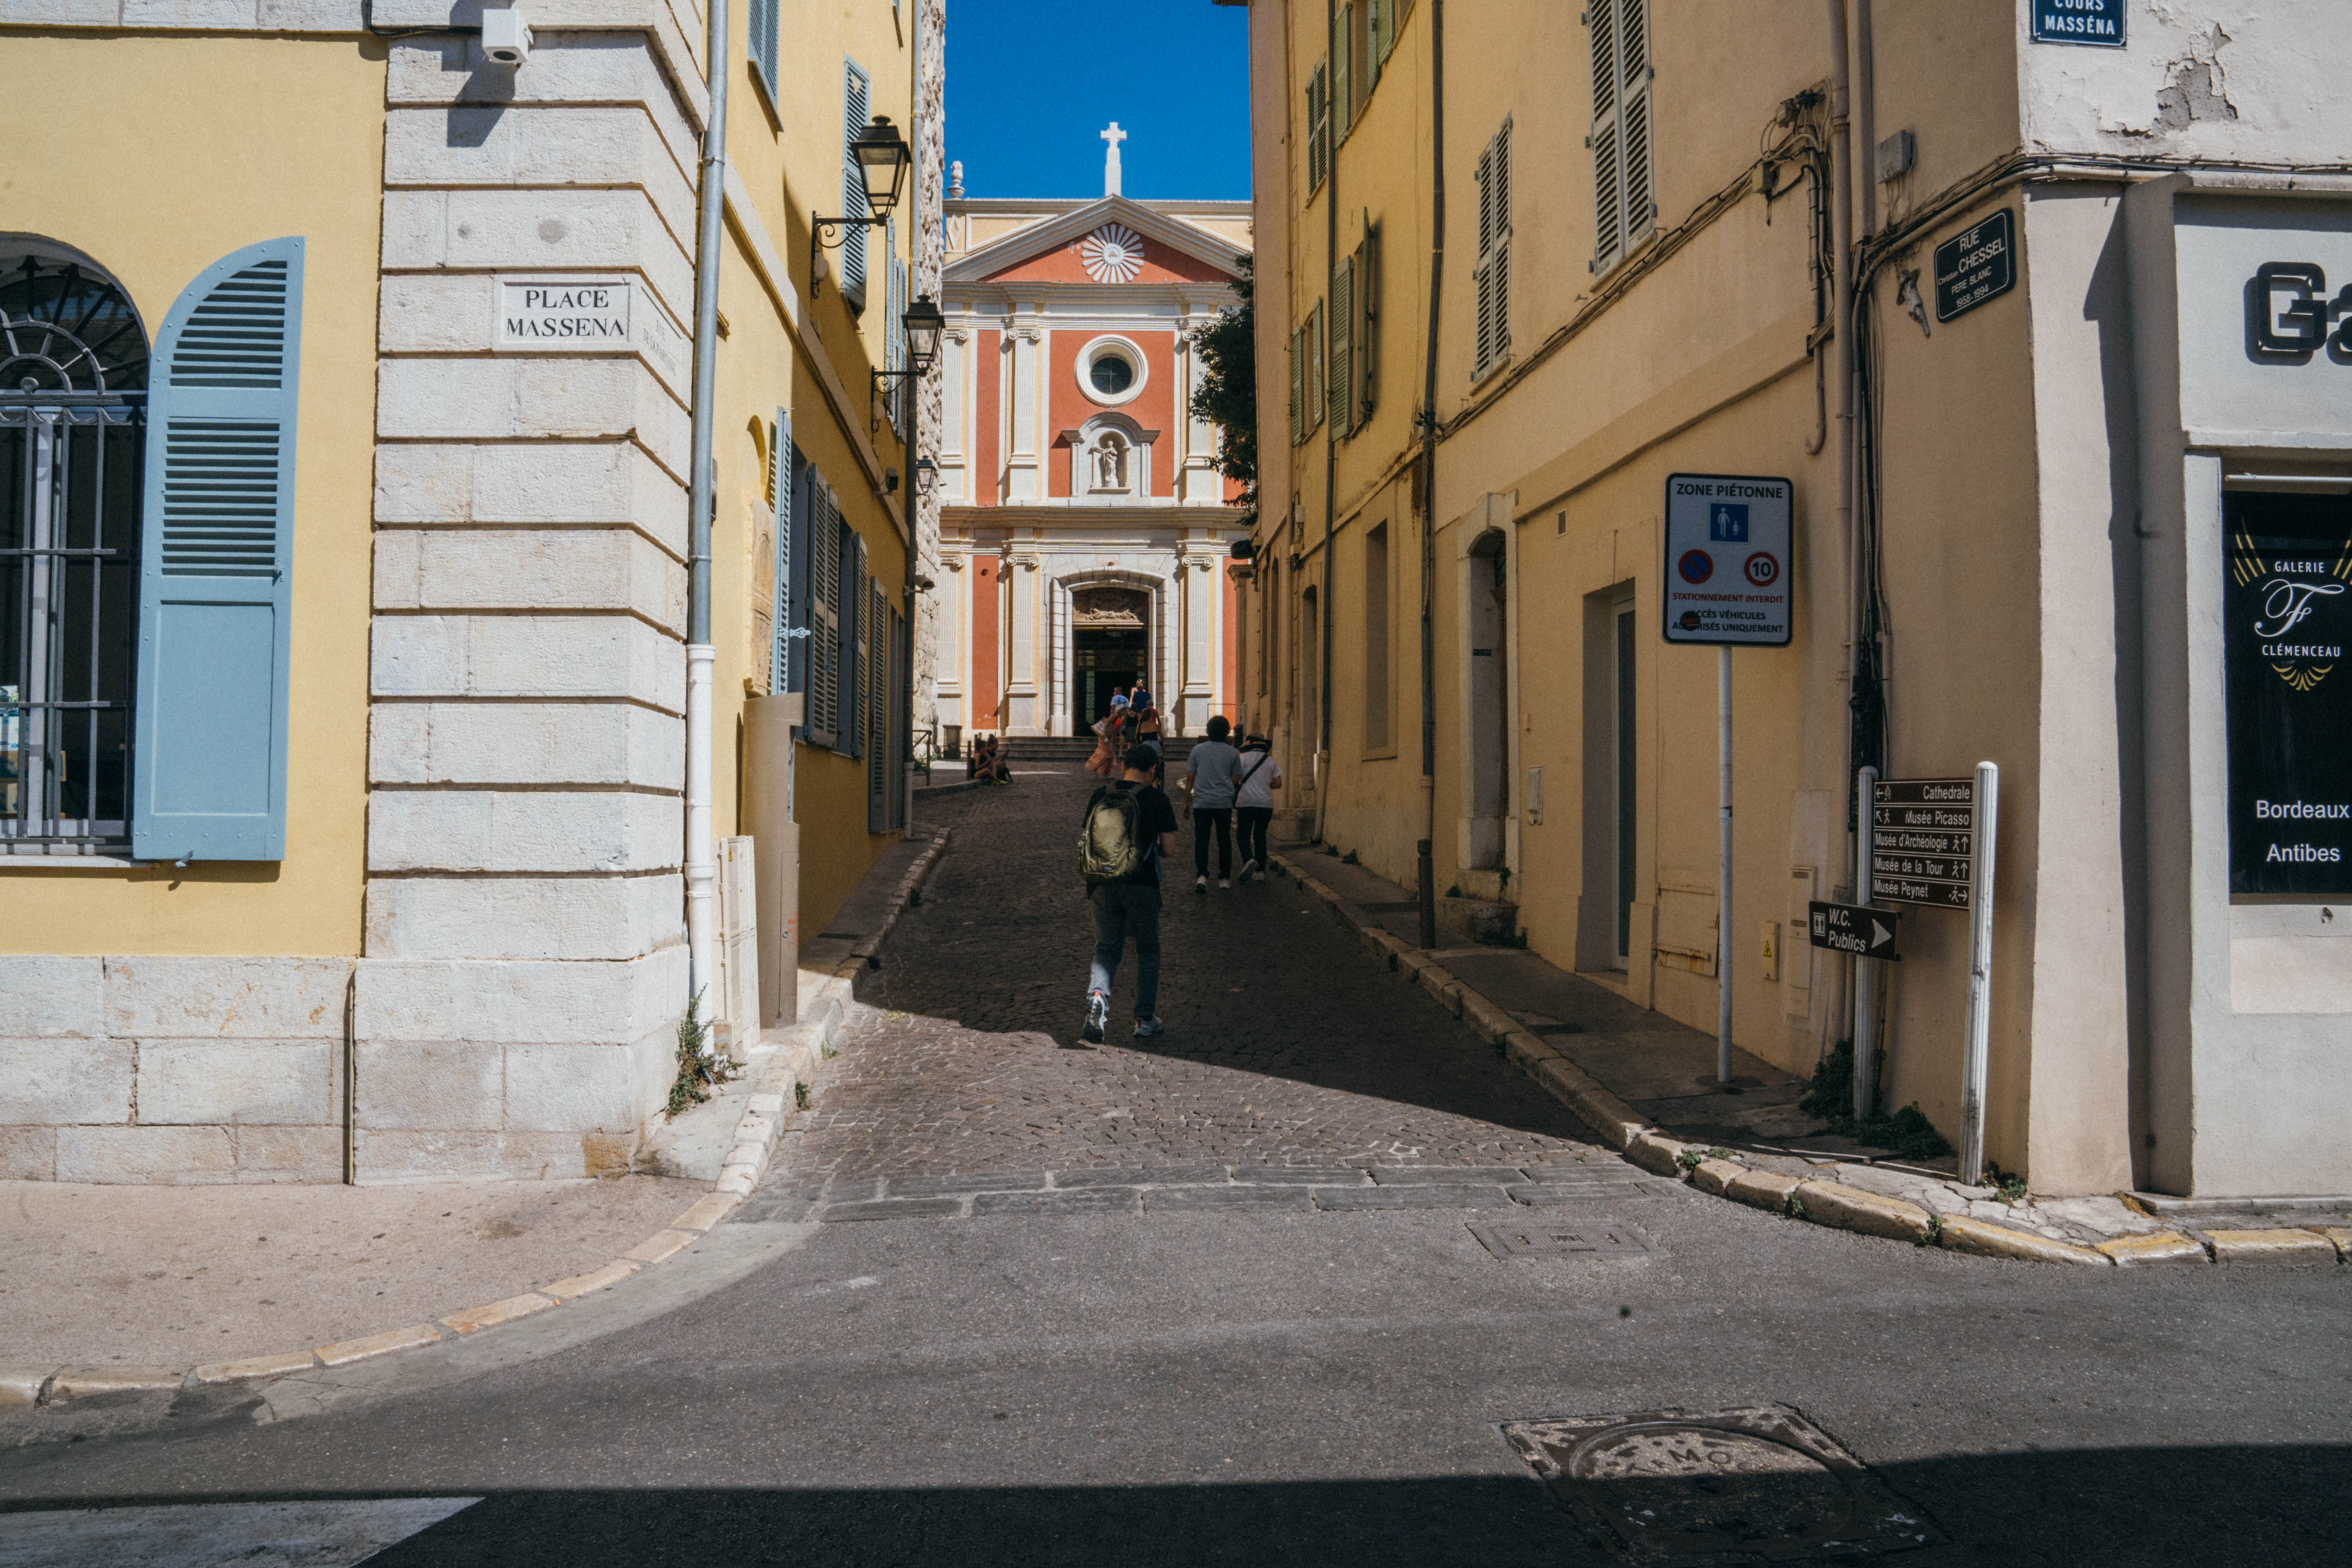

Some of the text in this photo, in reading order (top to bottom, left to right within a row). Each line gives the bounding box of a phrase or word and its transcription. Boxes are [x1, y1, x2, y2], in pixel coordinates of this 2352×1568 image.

[2045, 15, 2115, 35] MASSÉNA
[1959, 229, 1979, 252] RUE
[1938, 238, 2005, 285] Christian CHESSEL
[1951, 266, 1992, 295] PERE BLANC
[525, 290, 608, 308] PLACE
[507, 318, 624, 336] MASSENA
[1677, 484, 1783, 498] ZONE PIÉTONNE
[1752, 562, 1771, 577] 10
[2274, 562, 2325, 573] GALERIE
[1672, 593, 1784, 603] STATIONNEMENT INTERDIT
[1719, 610, 1766, 619] VÉHICULES
[1722, 624, 1783, 632] UNIQUEMENT
[2262, 643, 2340, 657] CLÉMENCEAU
[1923, 785, 1970, 800] Cathedrale
[1905, 811, 1970, 825] Musée Picasso
[2256, 800, 2350, 819] Bordeaux
[1875, 833, 1948, 851] Musée d'Archéologie
[2266, 844, 2341, 862] Antibes
[1875, 857, 1943, 875] Musée de la Tour
[1874, 879, 1928, 899] Musée Peynet
[1829, 909, 1850, 927] W.C.
[1828, 931, 1866, 952] Publics
